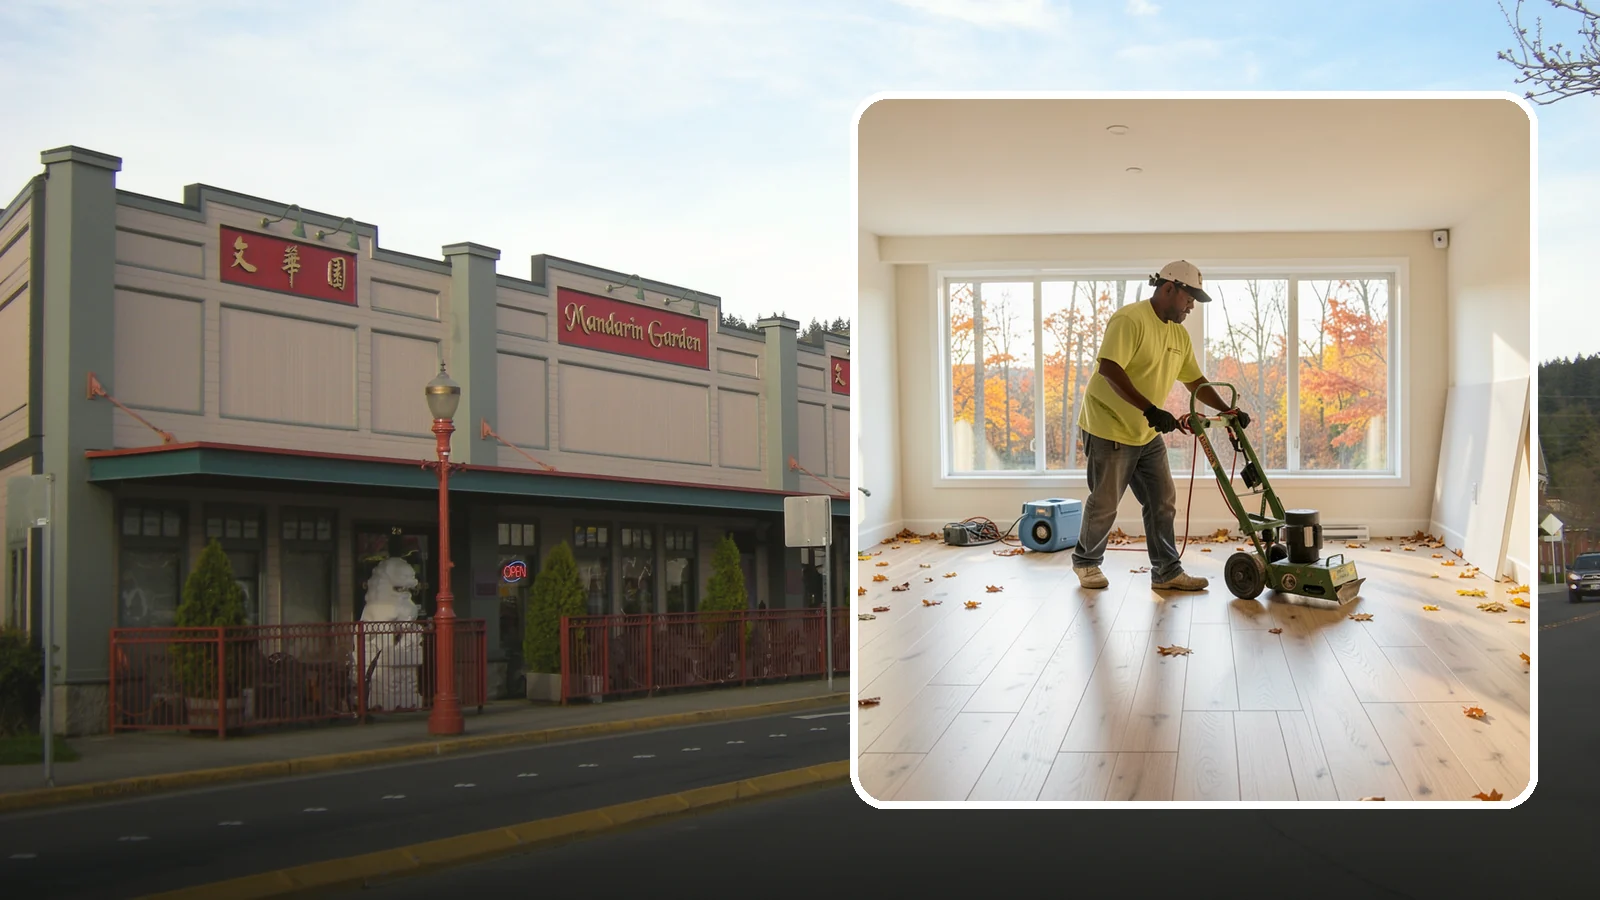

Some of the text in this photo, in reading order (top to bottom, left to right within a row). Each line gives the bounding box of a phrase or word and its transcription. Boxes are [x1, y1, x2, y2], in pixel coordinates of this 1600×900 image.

[564, 302, 701, 352] Mandarin Garden
[835, 363, 847, 386] 文
[503, 565, 527, 578] OPEN
